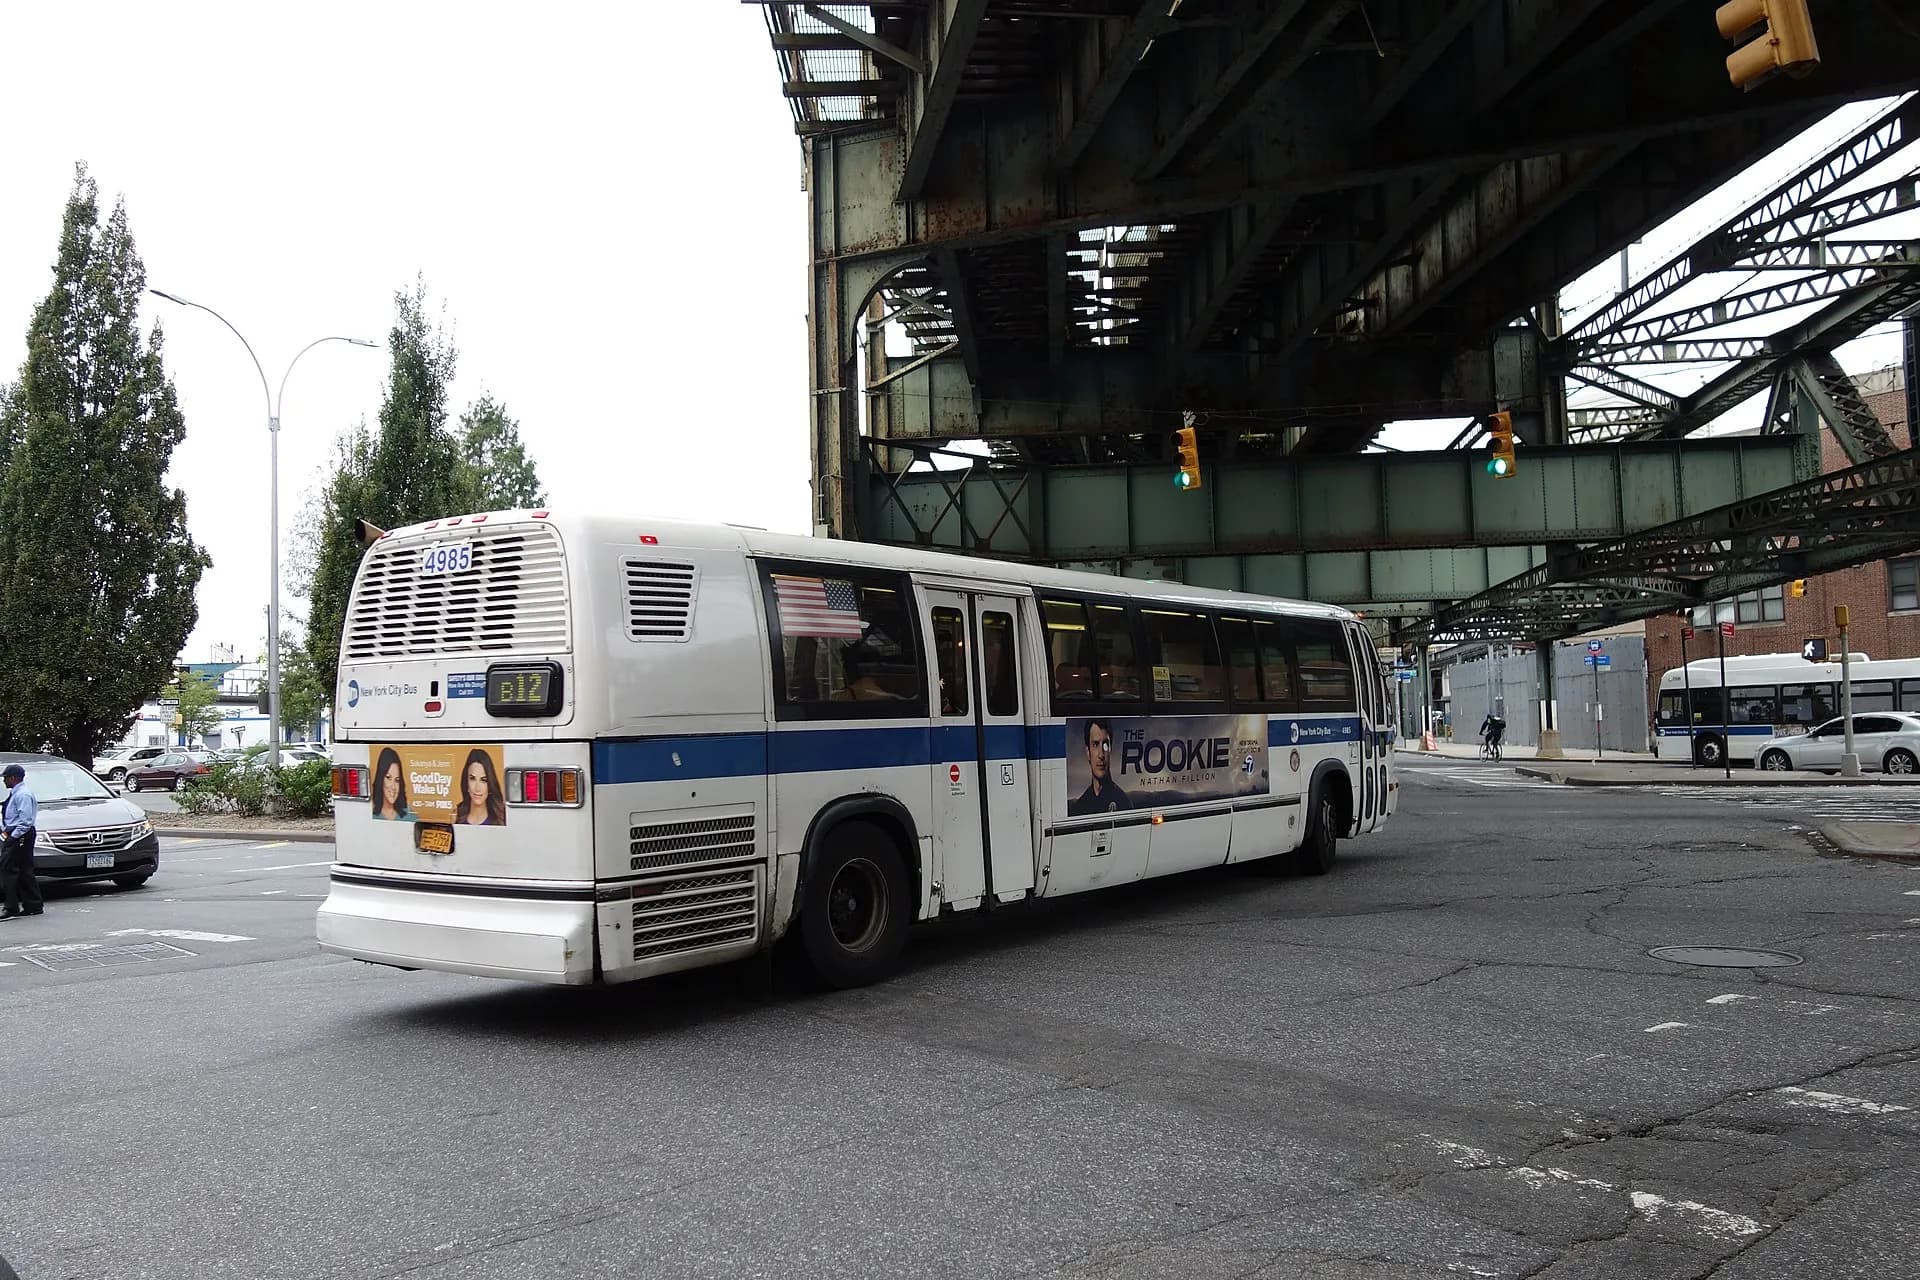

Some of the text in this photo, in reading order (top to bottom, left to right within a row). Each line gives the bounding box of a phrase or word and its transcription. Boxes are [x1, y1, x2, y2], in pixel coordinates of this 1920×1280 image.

[425, 547, 469, 573] 4985
[361, 684, 417, 697] New York City Bus
[501, 673, 542, 702] B12
[1123, 729, 1144, 741] THE
[1120, 737, 1231, 775] ROOKIE
[1140, 772, 1216, 786] NATHAN FILLION
[412, 783, 448, 797] Wake Up
